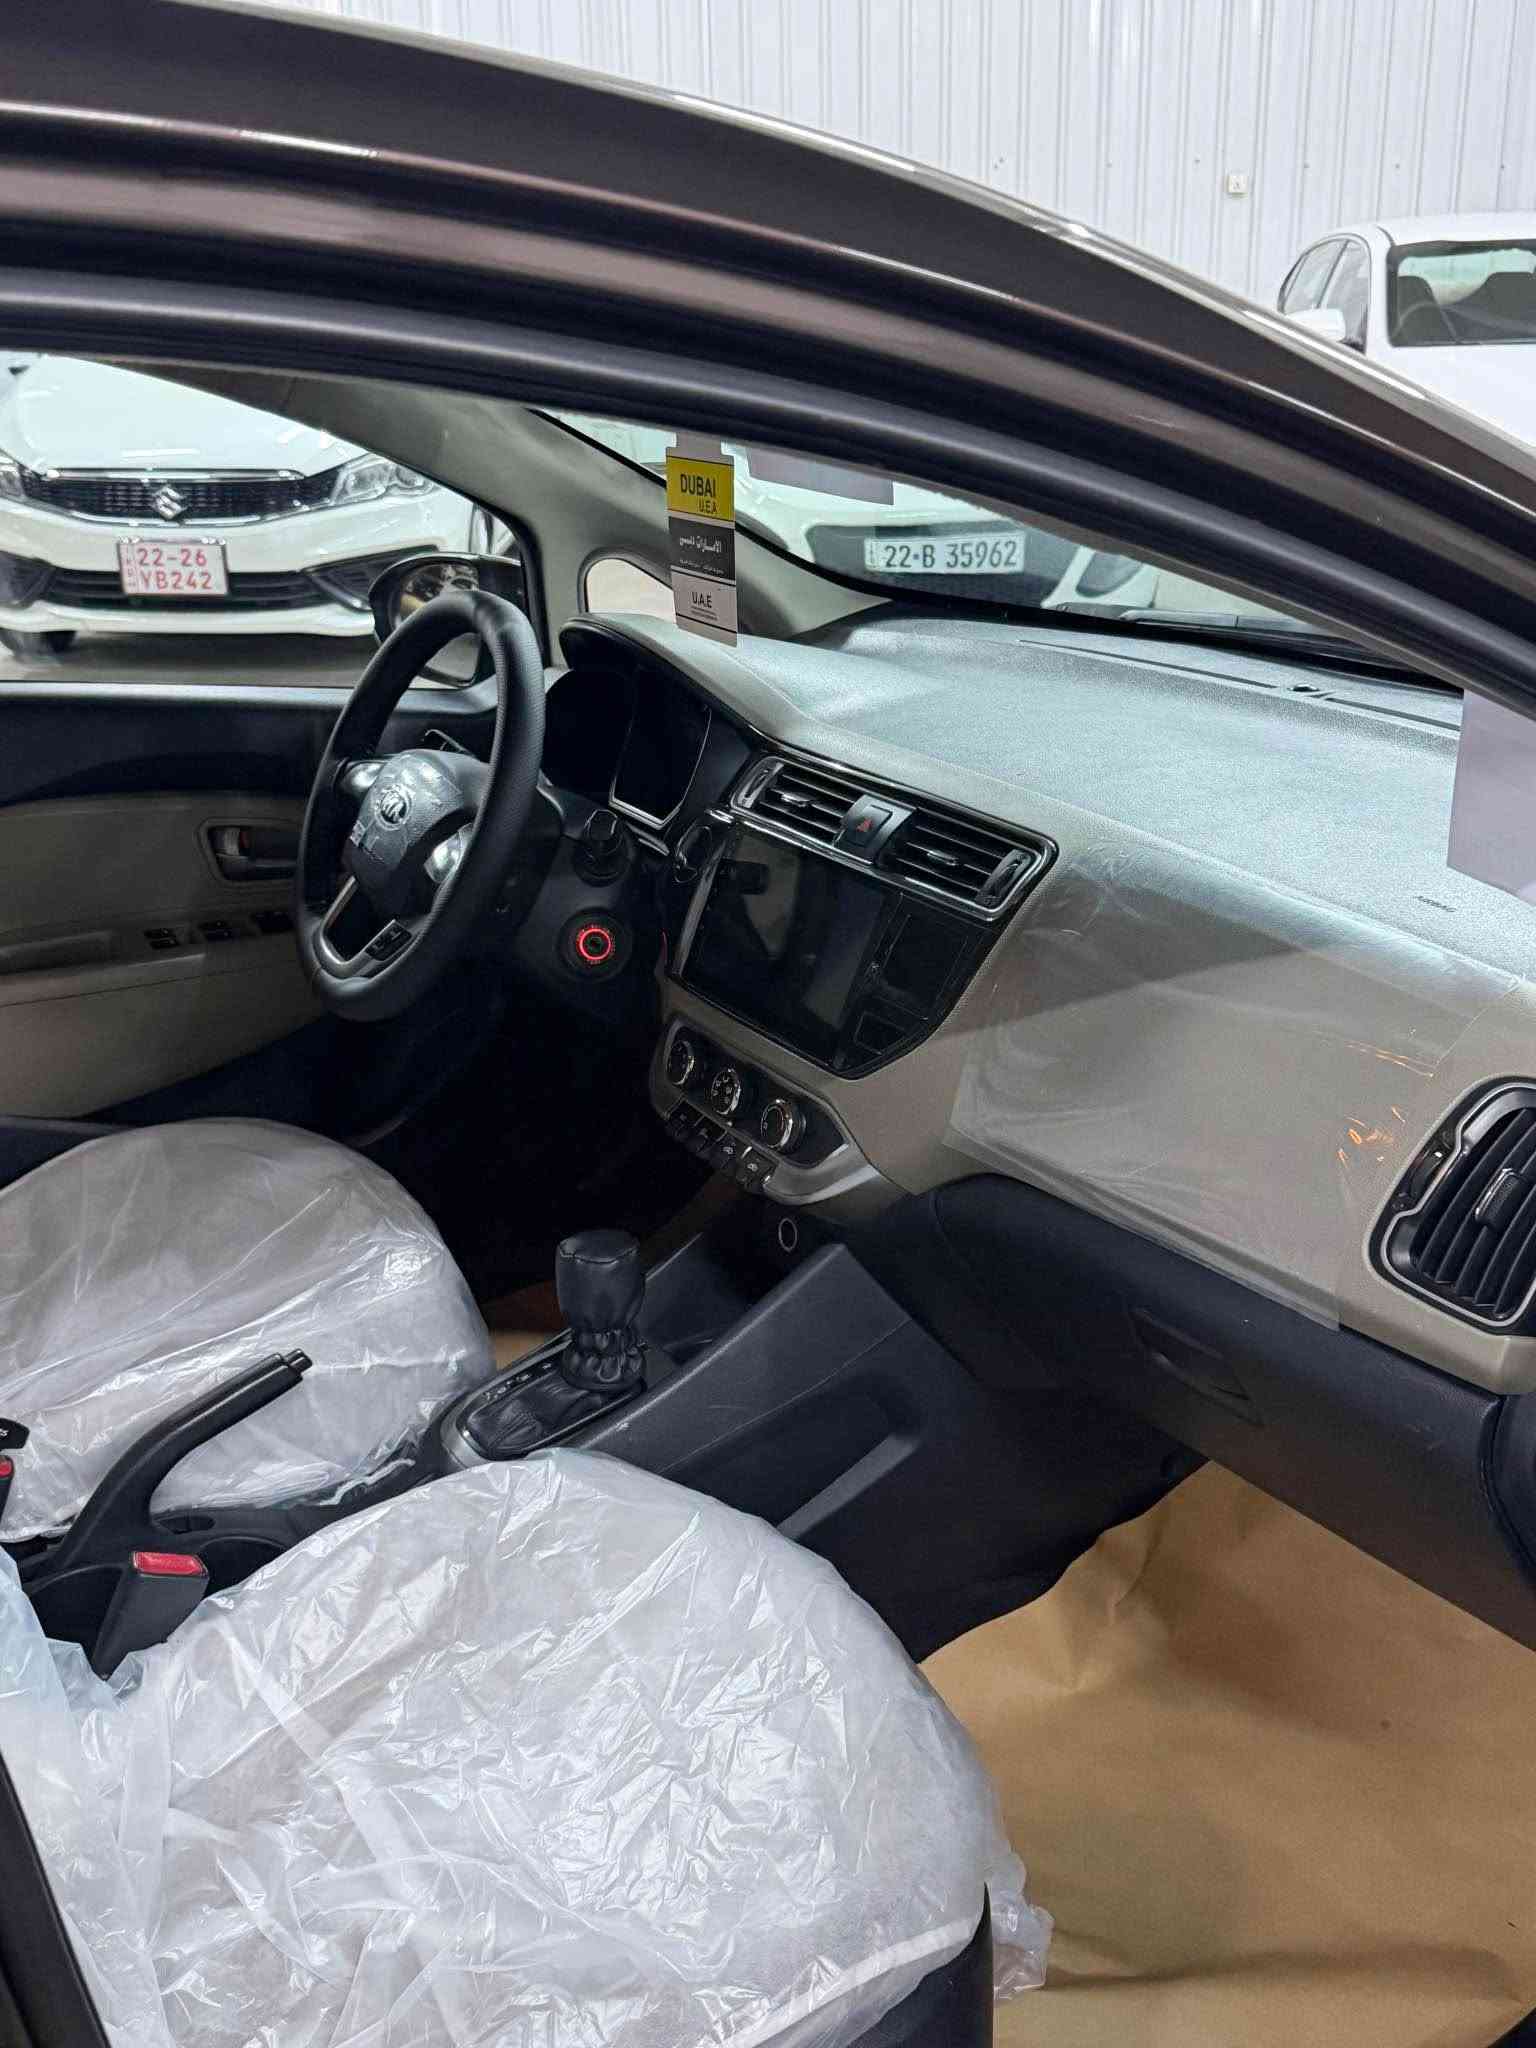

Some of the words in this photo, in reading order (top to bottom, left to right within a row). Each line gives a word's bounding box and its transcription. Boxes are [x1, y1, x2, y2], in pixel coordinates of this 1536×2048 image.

[680, 473, 716, 498] DUBAI
[137, 547, 207, 567] 22-26
[945, 540, 1018, 569] 35962
